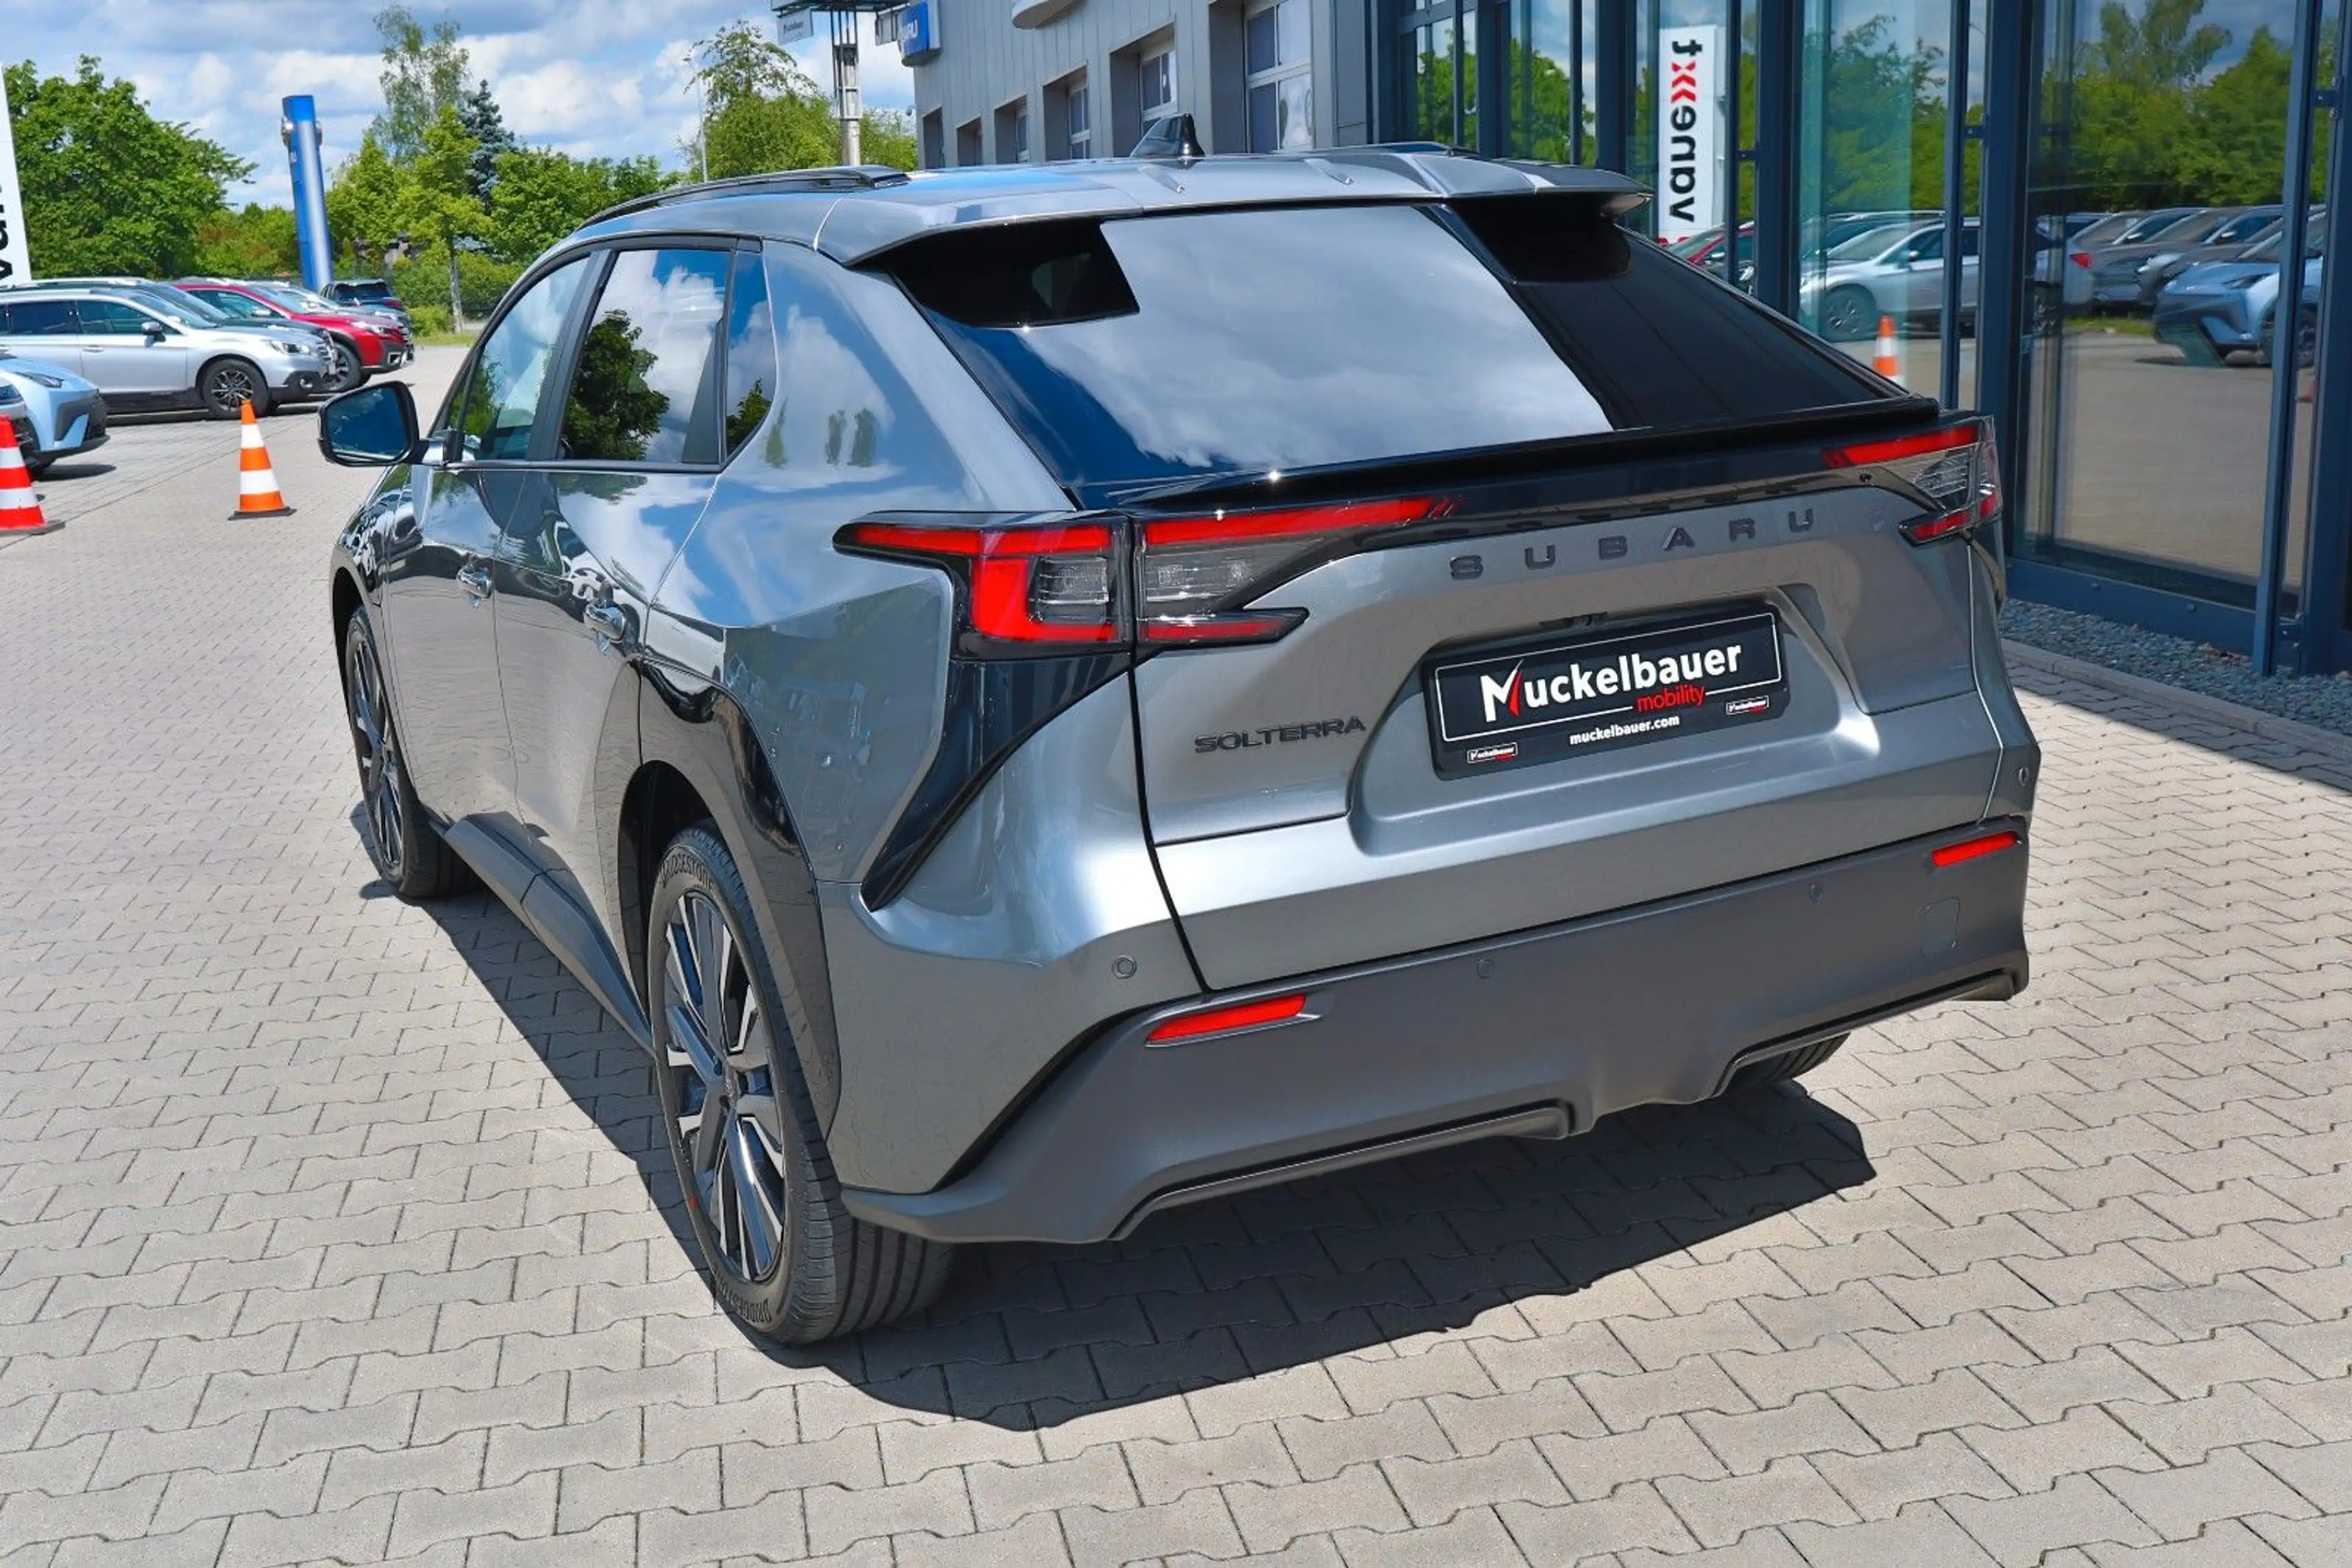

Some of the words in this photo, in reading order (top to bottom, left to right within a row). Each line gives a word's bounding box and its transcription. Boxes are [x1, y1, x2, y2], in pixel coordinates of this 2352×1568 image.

[1449, 508, 1814, 580] SUBARU
[1480, 643, 1743, 723] Muckelbauer
[1637, 684, 1707, 714] mobility
[1194, 715, 1366, 753] SOLTERRA
[1570, 714, 1681, 745] muckelbauer.com
